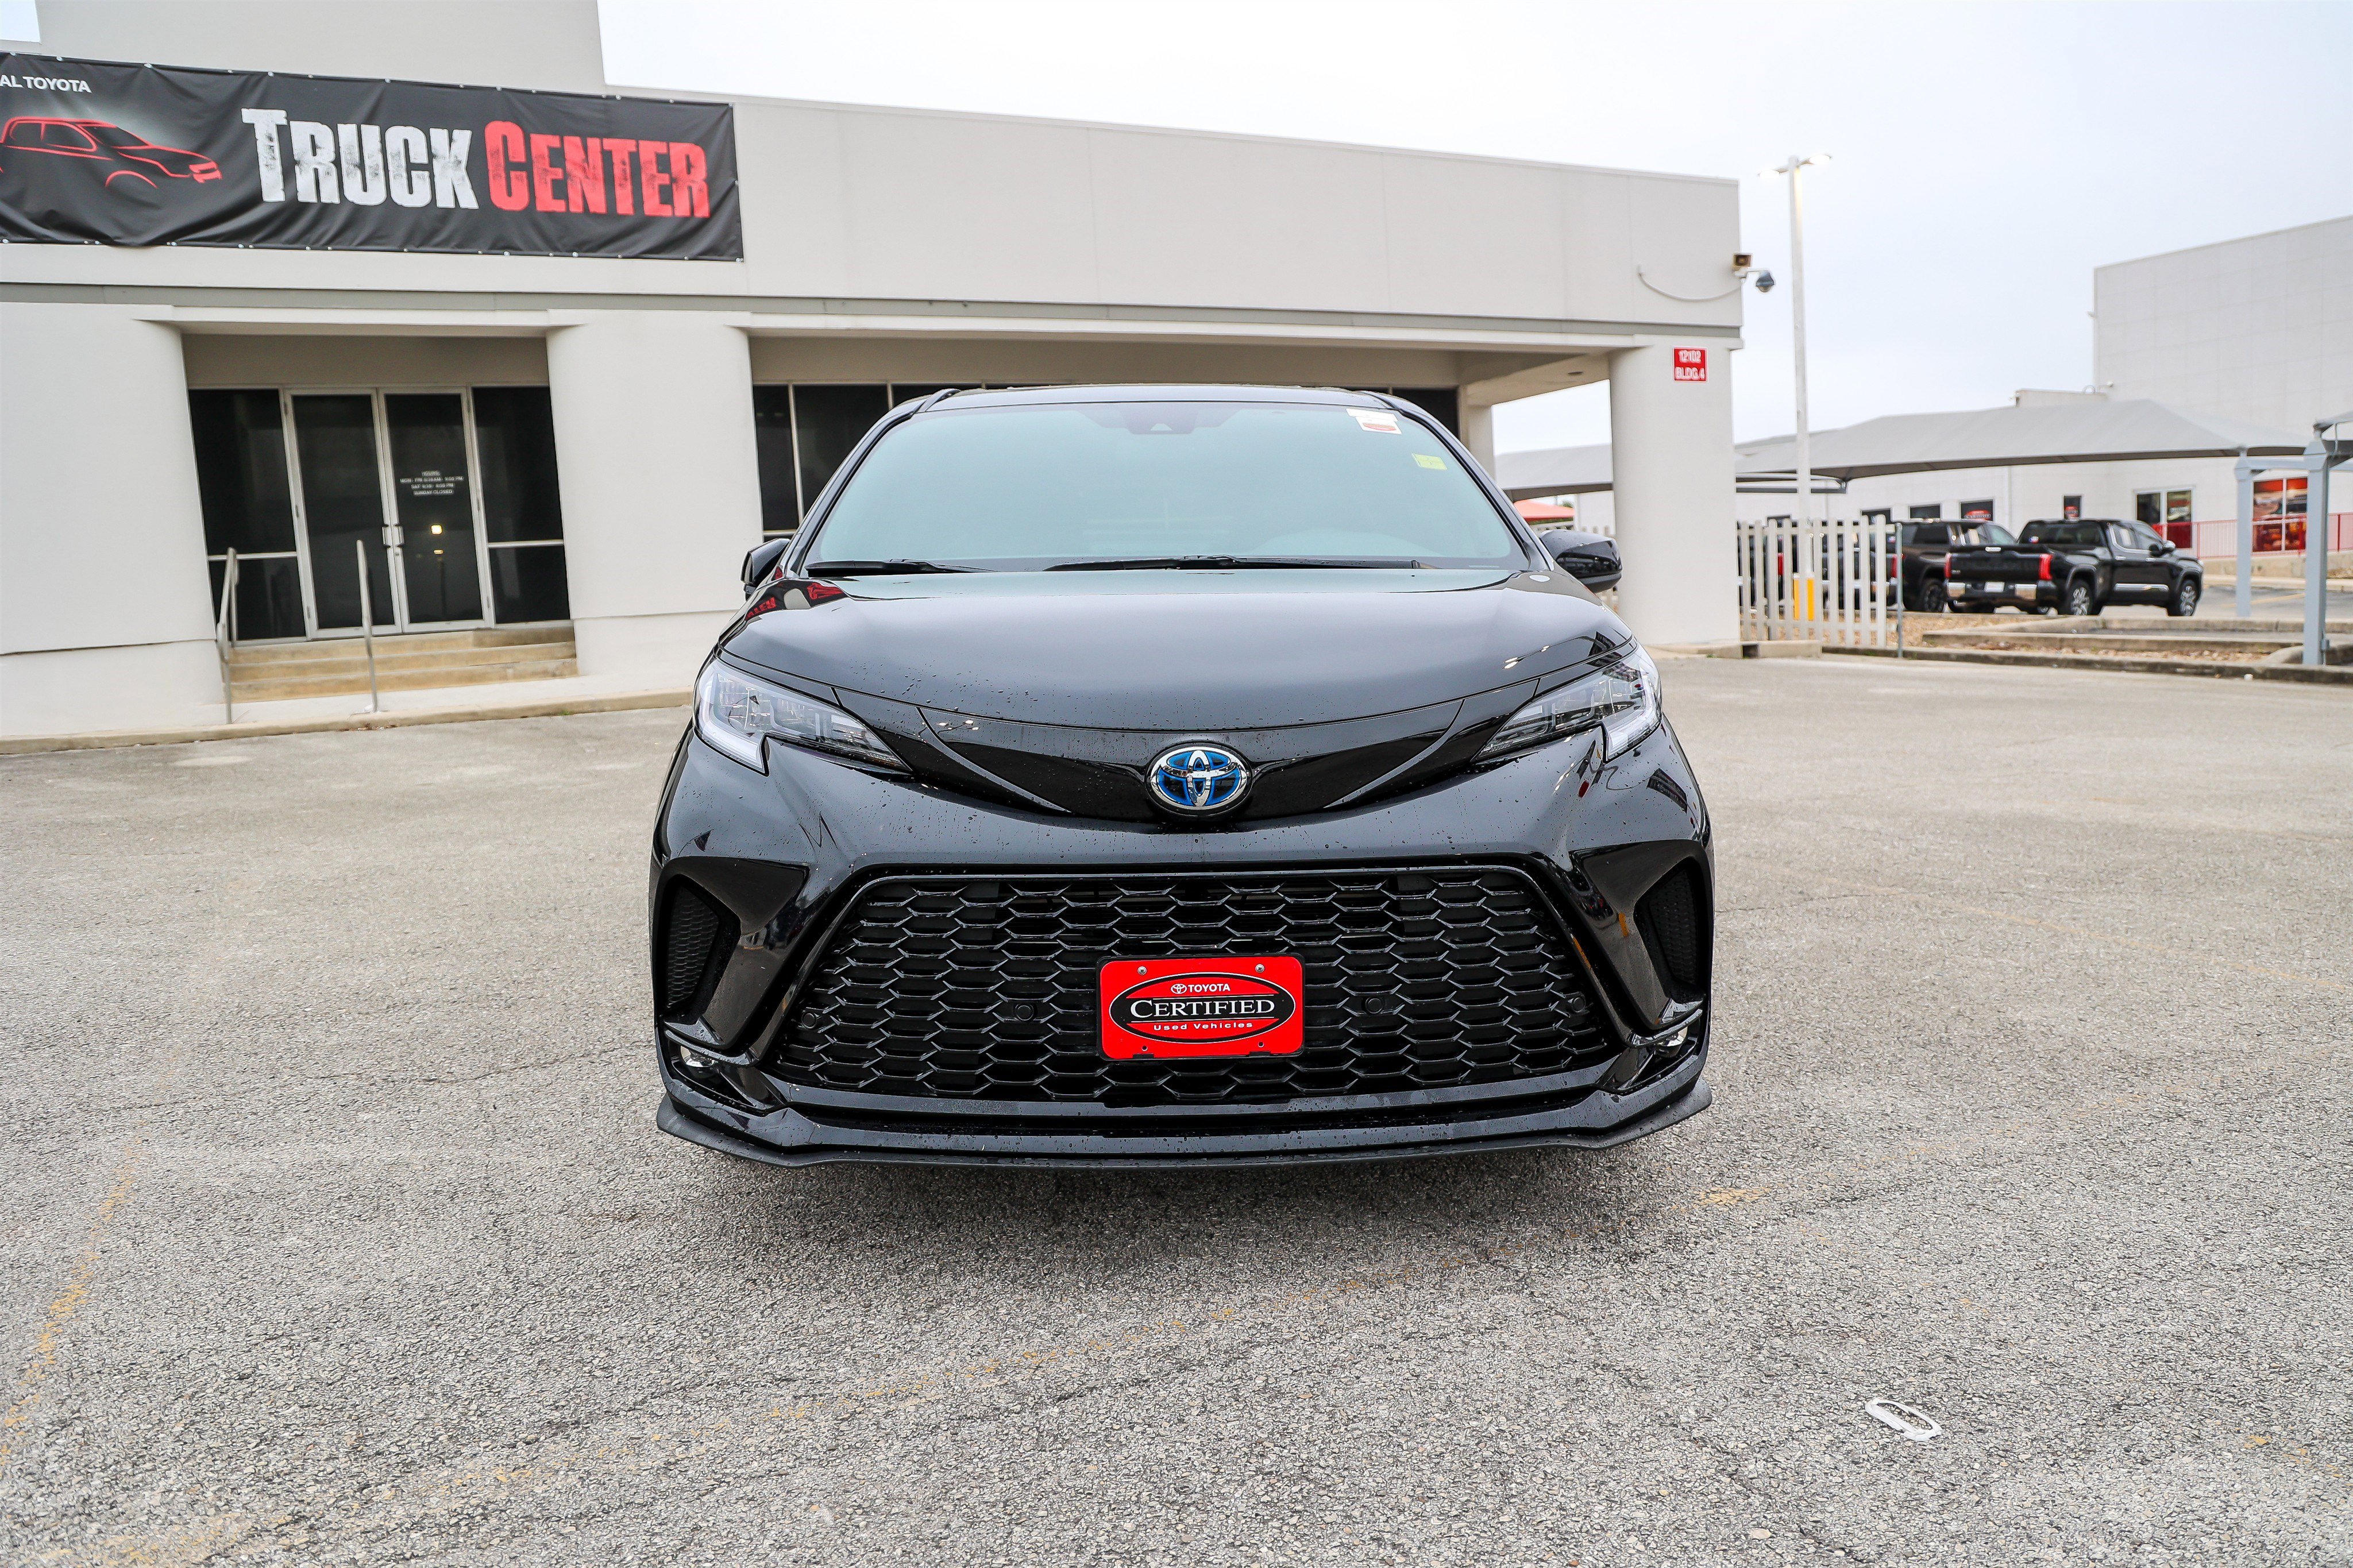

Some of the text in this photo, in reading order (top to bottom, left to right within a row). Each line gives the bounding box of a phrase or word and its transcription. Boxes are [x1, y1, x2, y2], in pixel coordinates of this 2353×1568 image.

[22, 75, 92, 94] TOYOTA
[241, 107, 711, 218] TRUCK CENTER
[1187, 983, 1231, 993] TOYOTA
[1193, 1022, 1253, 1030] Vehicles
